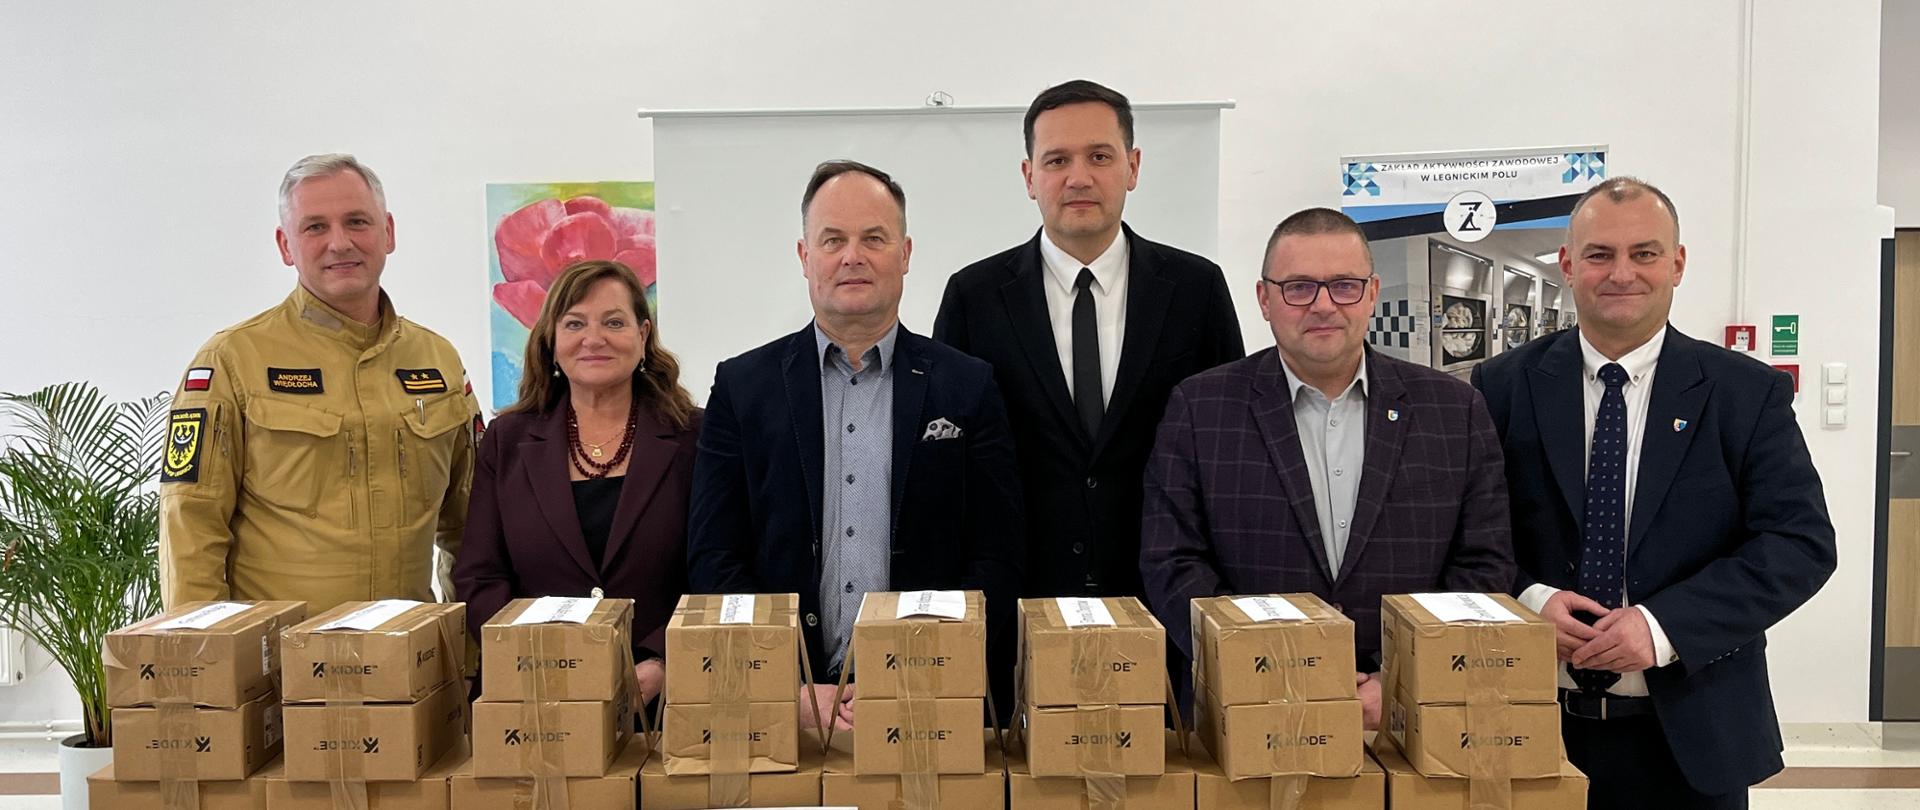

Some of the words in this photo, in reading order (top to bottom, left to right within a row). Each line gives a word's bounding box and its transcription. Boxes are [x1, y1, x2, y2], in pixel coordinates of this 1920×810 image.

[1492, 156, 1559, 168] ZAWODOWEJ
[1420, 174, 1430, 182] W
[1433, 172, 1489, 182] LEGNICKIM
[1492, 171, 1518, 180] POLU
[331, 665, 372, 675] KIDDE
[523, 732, 564, 742] KIDDE
